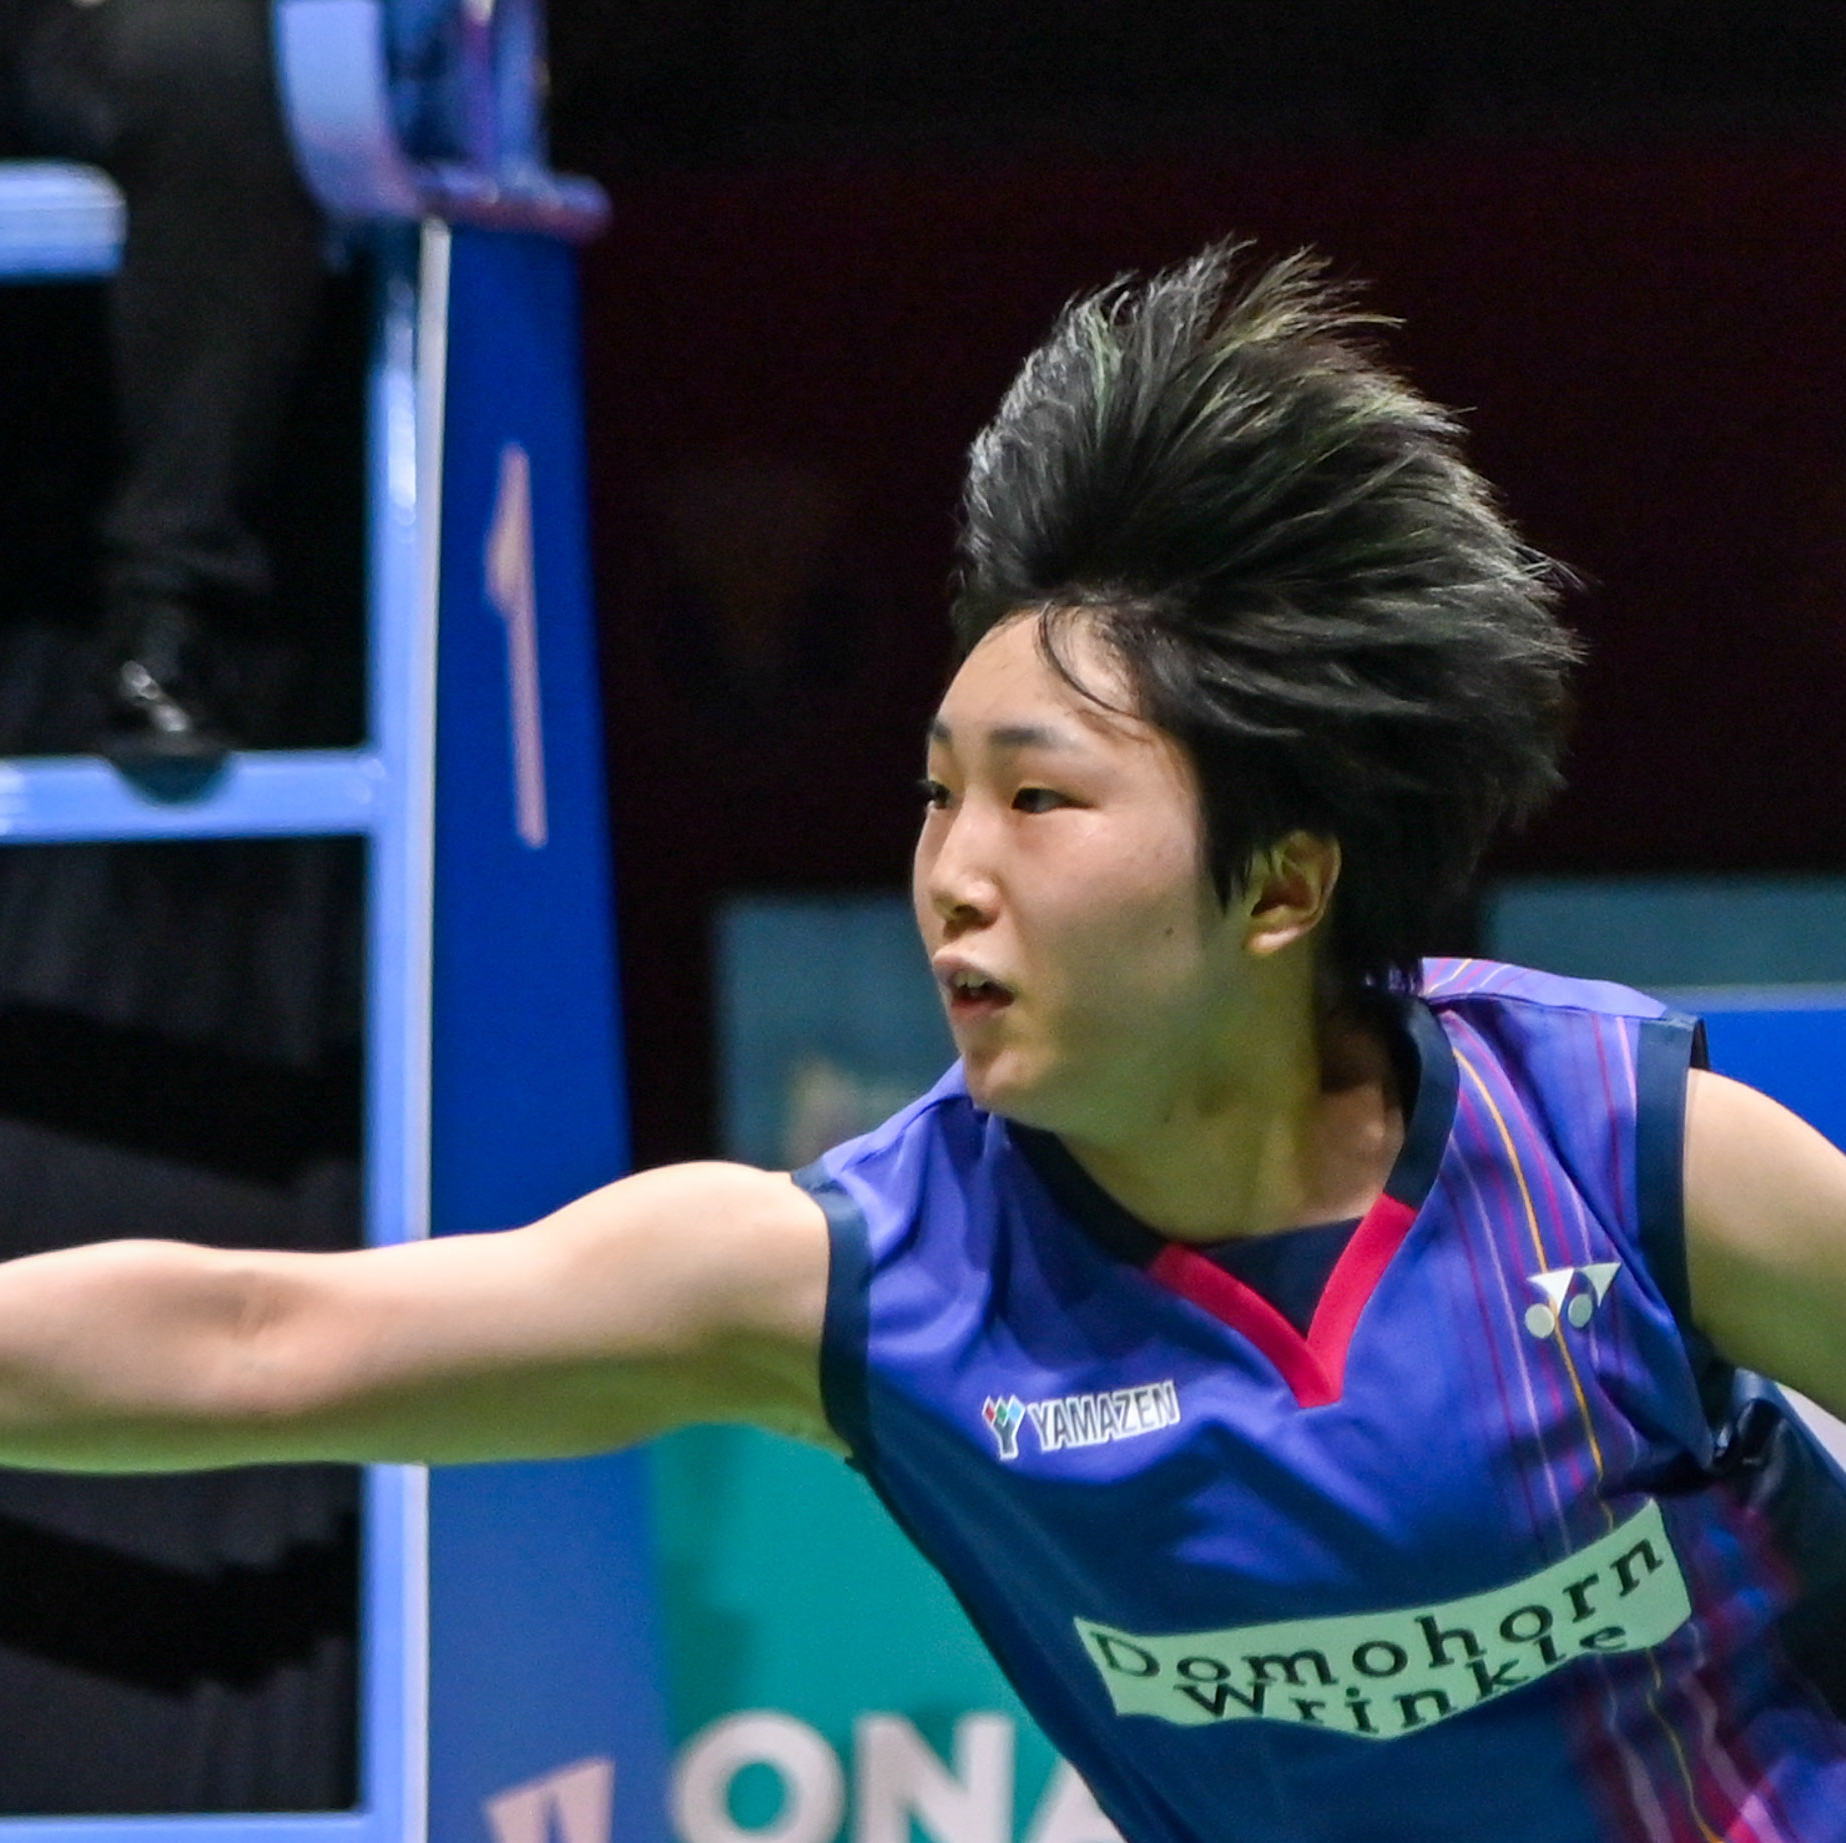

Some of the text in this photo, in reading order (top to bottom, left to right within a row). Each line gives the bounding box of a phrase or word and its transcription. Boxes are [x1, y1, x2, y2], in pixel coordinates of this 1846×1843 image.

[485, 444, 547, 846] 1
[1026, 1380, 1181, 1453] YAMAZEN
[1090, 1535, 1665, 1691] Domohorn
[1173, 1622, 1627, 1736] Wrinkle
